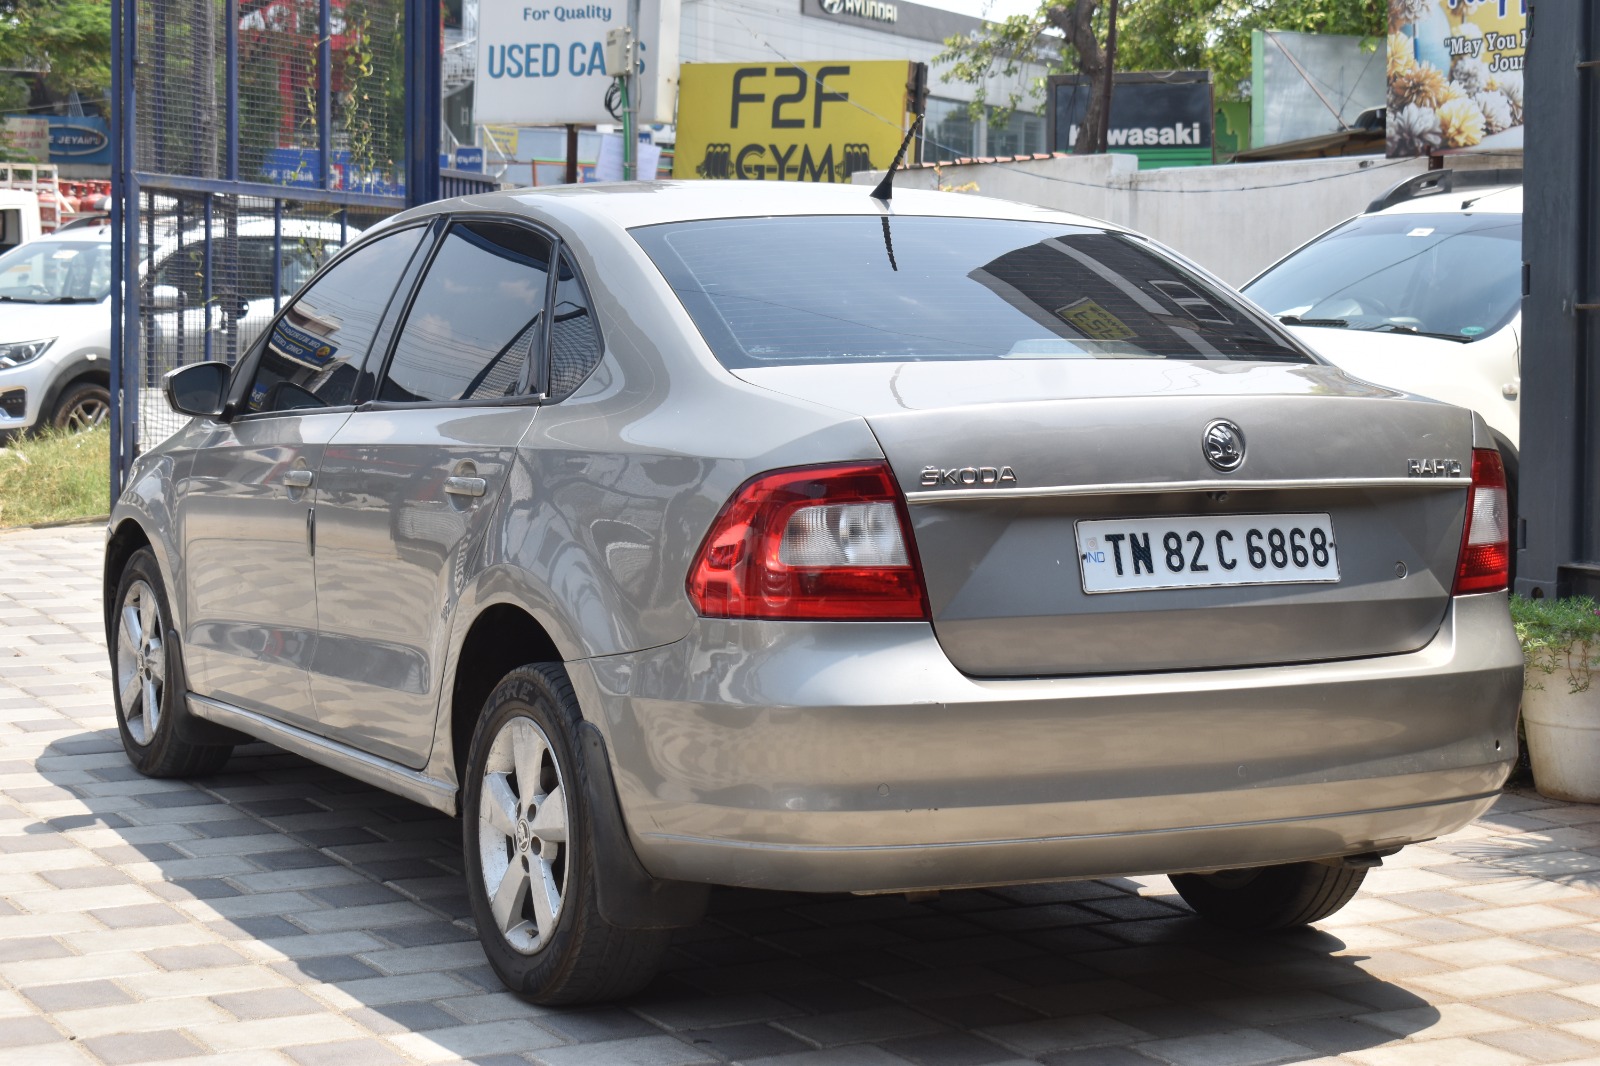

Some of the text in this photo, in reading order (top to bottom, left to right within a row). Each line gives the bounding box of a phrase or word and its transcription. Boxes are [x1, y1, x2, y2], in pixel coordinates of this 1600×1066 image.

[523, 4, 613, 23] For Quality
[1485, 32, 1516, 52] You
[487, 41, 646, 79] USED CA
[730, 65, 850, 130] F2F
[1069, 122, 1200, 147] Kwasaki
[735, 143, 836, 183] GYM
[919, 464, 1017, 487] ŠKODA
[1085, 551, 1106, 563] IND
[1104, 526, 1331, 577] TN 82 C 6868
